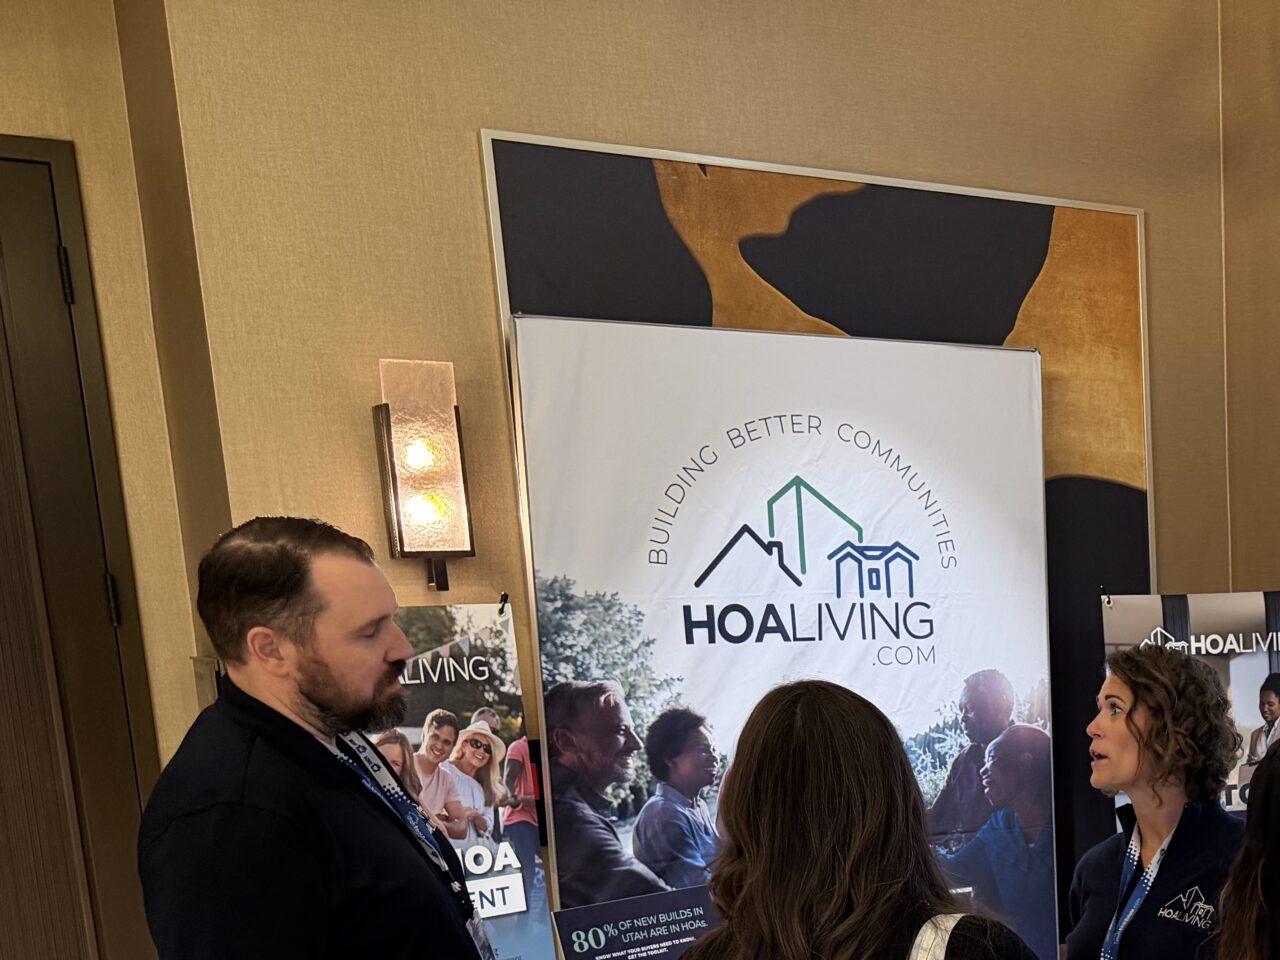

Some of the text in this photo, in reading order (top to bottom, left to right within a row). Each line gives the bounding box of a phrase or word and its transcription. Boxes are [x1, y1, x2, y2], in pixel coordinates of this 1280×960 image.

[648, 414, 957, 569] BUILDING BETTER COMMUNITIES
[682, 602, 935, 645] HOALIVING
[398, 656, 490, 685] LIVING
[872, 645, 936, 666] .COM
[455, 841, 522, 875] OA
[571, 906, 704, 953] 80% OF NEW BUILDS IN
[621, 930, 648, 943] UTAH
[649, 927, 669, 938] ARE
[670, 923, 680, 934] IN
[1157, 907, 1212, 928] HOALIVING
